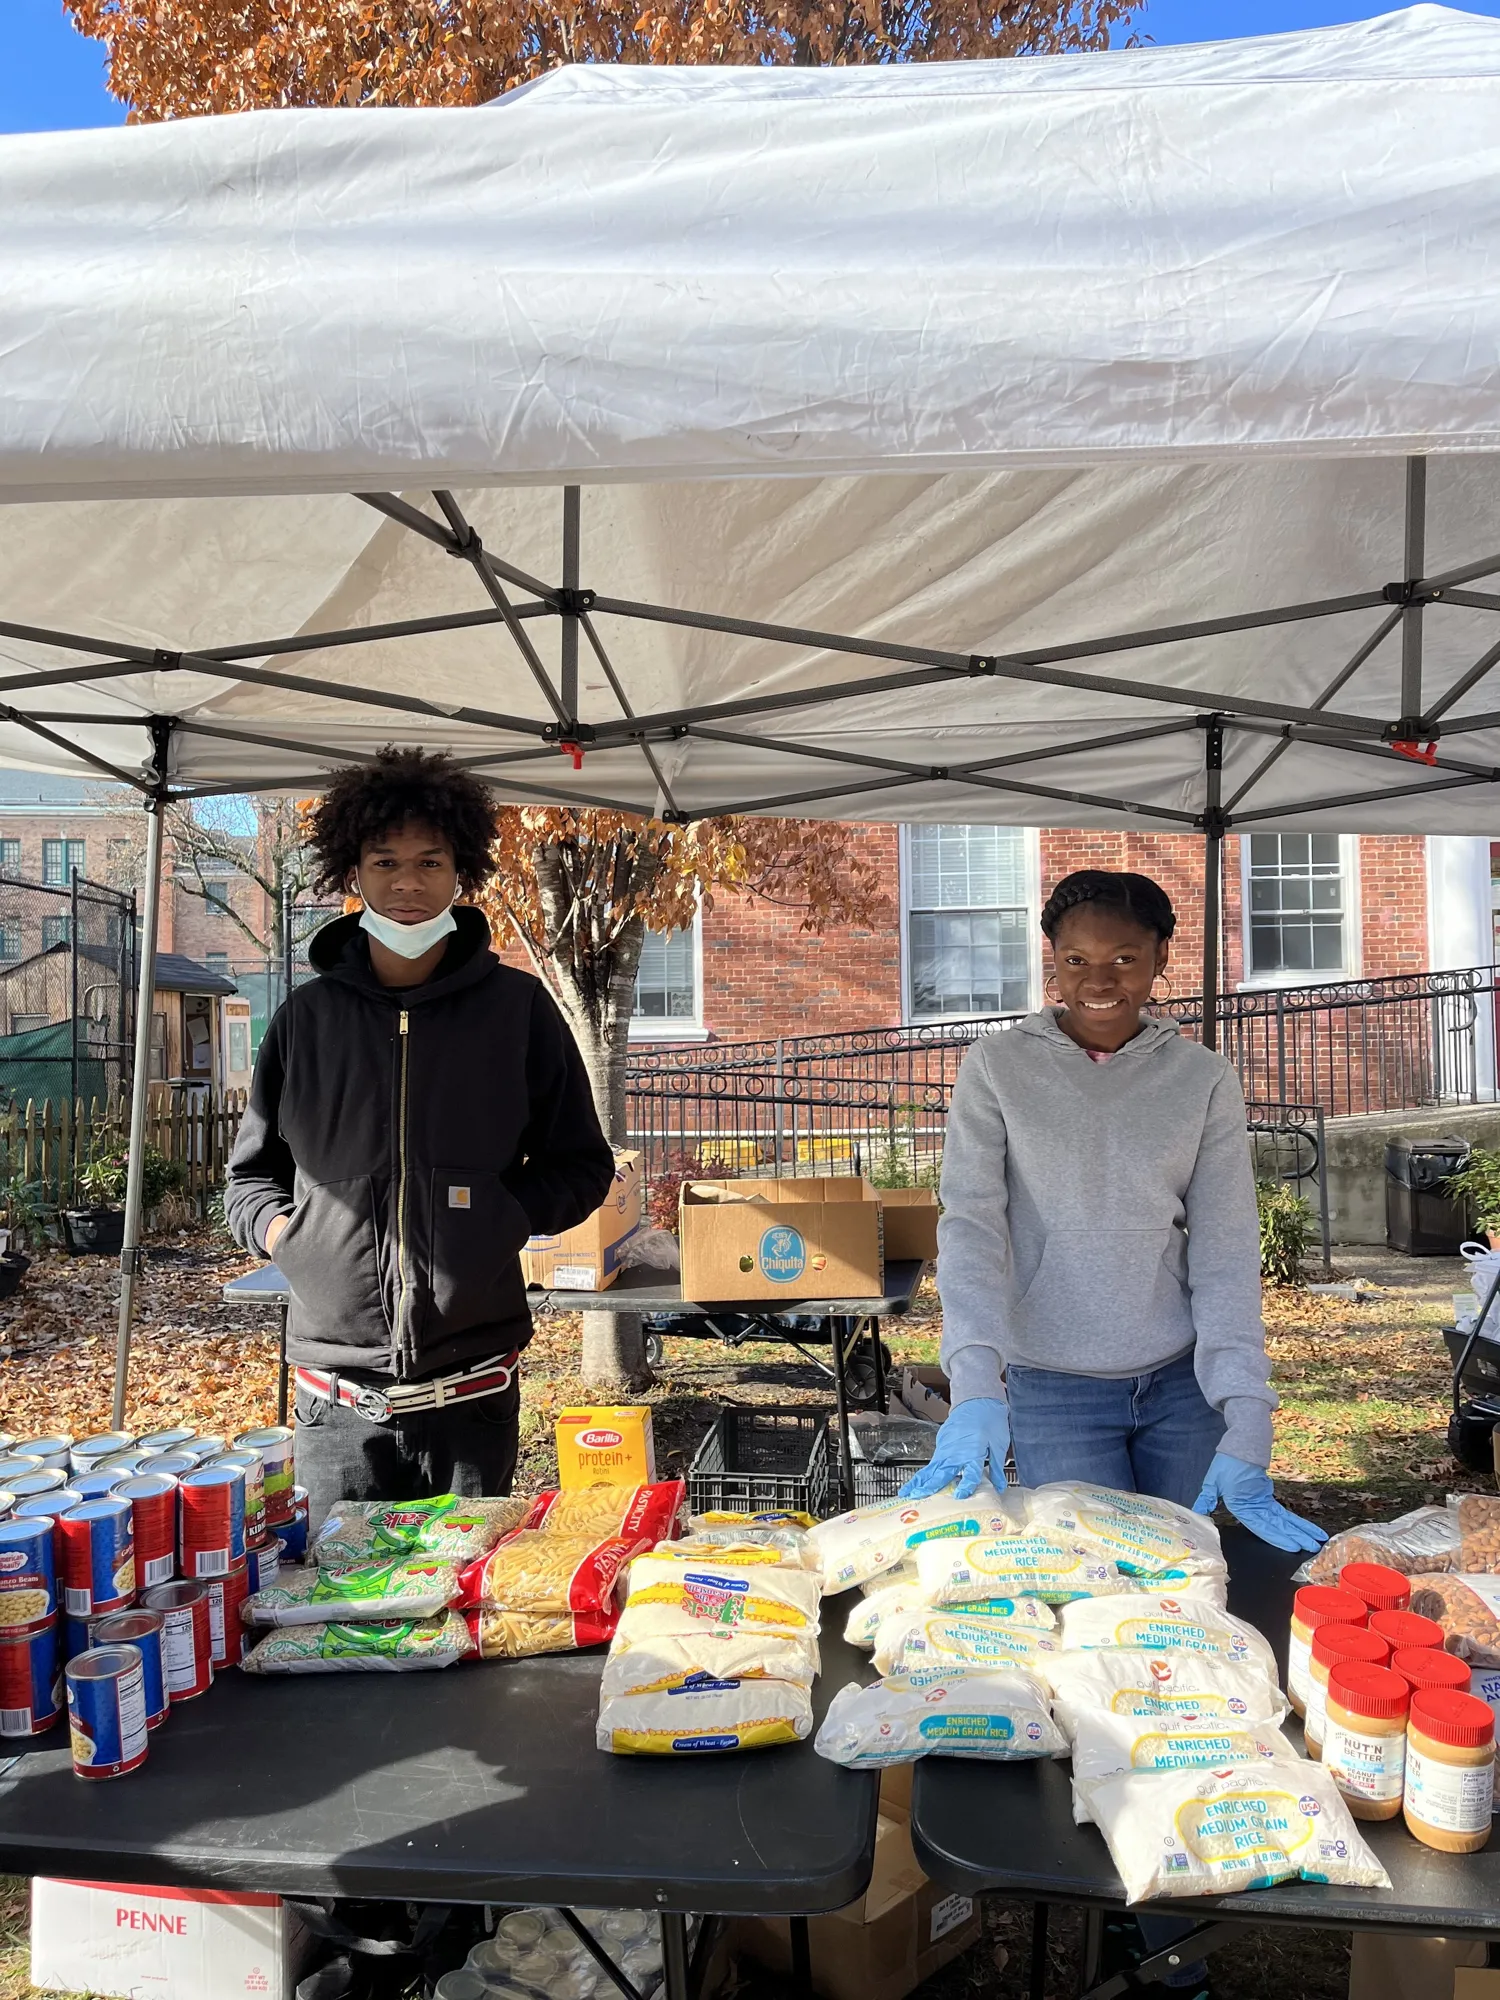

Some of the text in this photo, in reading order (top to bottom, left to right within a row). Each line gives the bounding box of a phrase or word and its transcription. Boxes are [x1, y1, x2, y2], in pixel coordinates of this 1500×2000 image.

[761, 1255, 804, 1273] Chiquita
[586, 1433, 620, 1444] Barilla
[382, 1512, 430, 1529] eak
[925, 1524, 959, 1540] ENRICHED
[1095, 1516, 1137, 1533] MEDIUM
[1140, 1529, 1172, 1546] GRAIN
[994, 1537, 1047, 1547] ENRICHED
[1101, 1538, 1114, 1547] NET
[1121, 1531, 1145, 1545] RICE
[984, 1546, 1064, 1558] MEDIUM GRAIN
[0, 1554, 24, 1562] merican
[1015, 1556, 1038, 1566] RICE
[998, 1574, 1012, 1582] NET
[695, 1593, 709, 1602] the
[1040, 1592, 1072, 1600] NRICHED
[967, 1604, 990, 1612] GRAIN
[991, 1606, 1008, 1615] RICE
[182, 1624, 192, 1632] 120
[1148, 1623, 1205, 1638] ENRICHED
[944, 1629, 990, 1642] MEDIUM
[1136, 1632, 1219, 1652] MEDIUM GRAIN
[1234, 1638, 1246, 1646] USA
[974, 1644, 1000, 1655] RICE
[1136, 1680, 1156, 1690] gulf
[1144, 1696, 1200, 1712] ENRICHED
[946, 1717, 988, 1726] ENRICHED
[1159, 1722, 1181, 1732] gulf
[926, 1728, 1008, 1738] MEDIUM GRAIN RICE
[693, 1740, 699, 1748] of
[1167, 1738, 1231, 1752] ENRICHED
[1344, 1738, 1383, 1754] NUT'N
[1344, 1747, 1382, 1762] BETTER
[1154, 1754, 1207, 1768] MEDIUM
[1347, 1767, 1376, 1778] PEANUT
[1347, 1772, 1376, 1783] BUTTER
[1196, 1782, 1218, 1796] gulf
[1205, 1800, 1266, 1818] ENRICHED
[1301, 1803, 1319, 1812] USA
[1196, 1815, 1288, 1838] MEDIUM GRAIN
[1234, 1832, 1265, 1850] RICE
[1221, 1860, 1238, 1870] NET
[116, 1908, 188, 1936] PENNE
